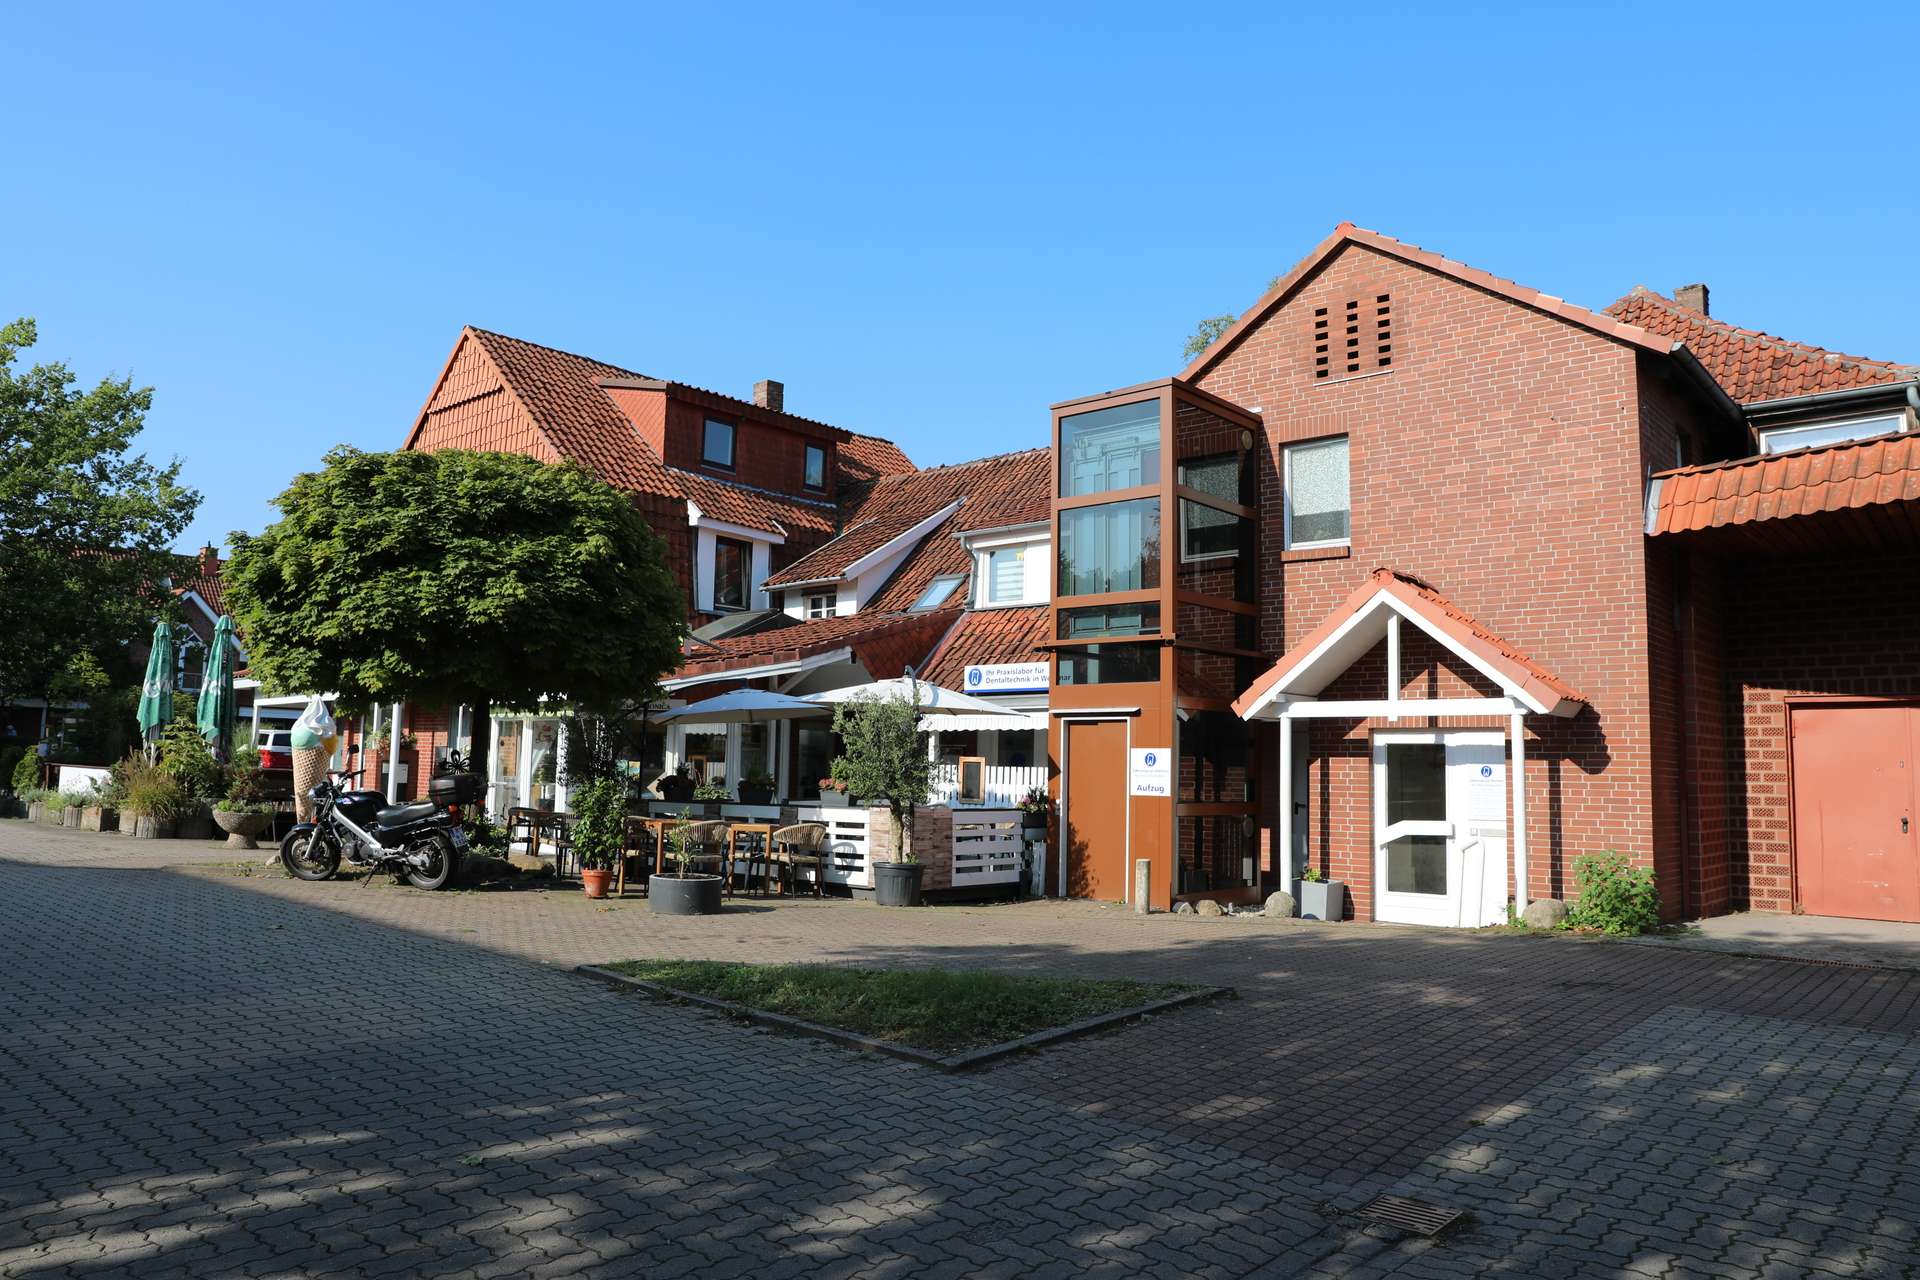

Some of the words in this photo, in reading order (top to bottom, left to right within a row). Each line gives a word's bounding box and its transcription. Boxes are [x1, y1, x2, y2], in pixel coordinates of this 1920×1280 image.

[997, 667, 1033, 675] Praxislabor
[986, 676, 1031, 684] Dentaltechnik
[1136, 784, 1165, 794] Aufzug
